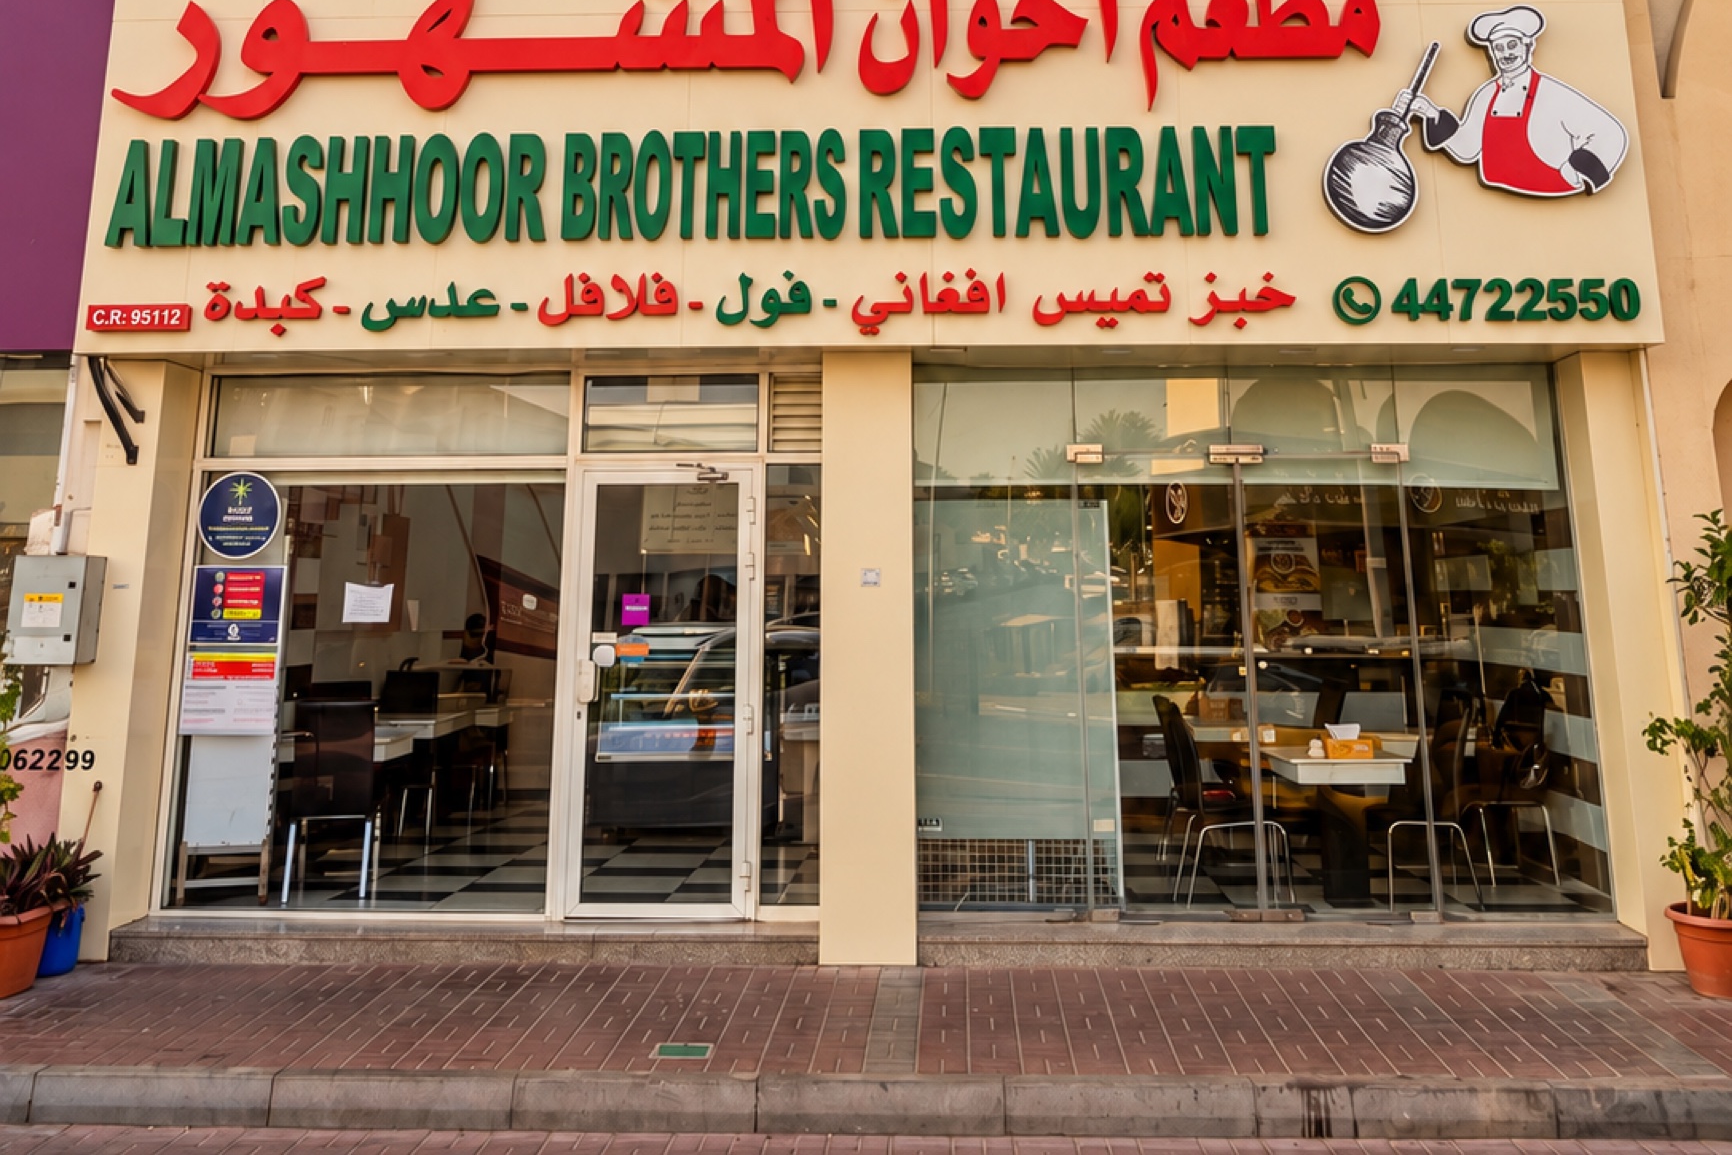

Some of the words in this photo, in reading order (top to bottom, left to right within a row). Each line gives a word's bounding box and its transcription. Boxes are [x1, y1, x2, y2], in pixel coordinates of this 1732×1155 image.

[105, 133, 546, 247] ALMASHHOOR
[561, 128, 847, 241] BROTHERS
[858, 125, 1277, 239] RESTAURANT
[92, 309, 127, 326] C.R:
[130, 308, 182, 326] 95112
[203, 276, 328, 337] كبدة
[360, 282, 500, 332] عدس
[536, 272, 680, 327] فلافل
[715, 271, 813, 327] فول
[851, 267, 1007, 336] افغاني
[1031, 271, 1173, 328] تميس
[1189, 271, 1298, 329] خبز
[1391, 277, 1641, 322] 44722550
